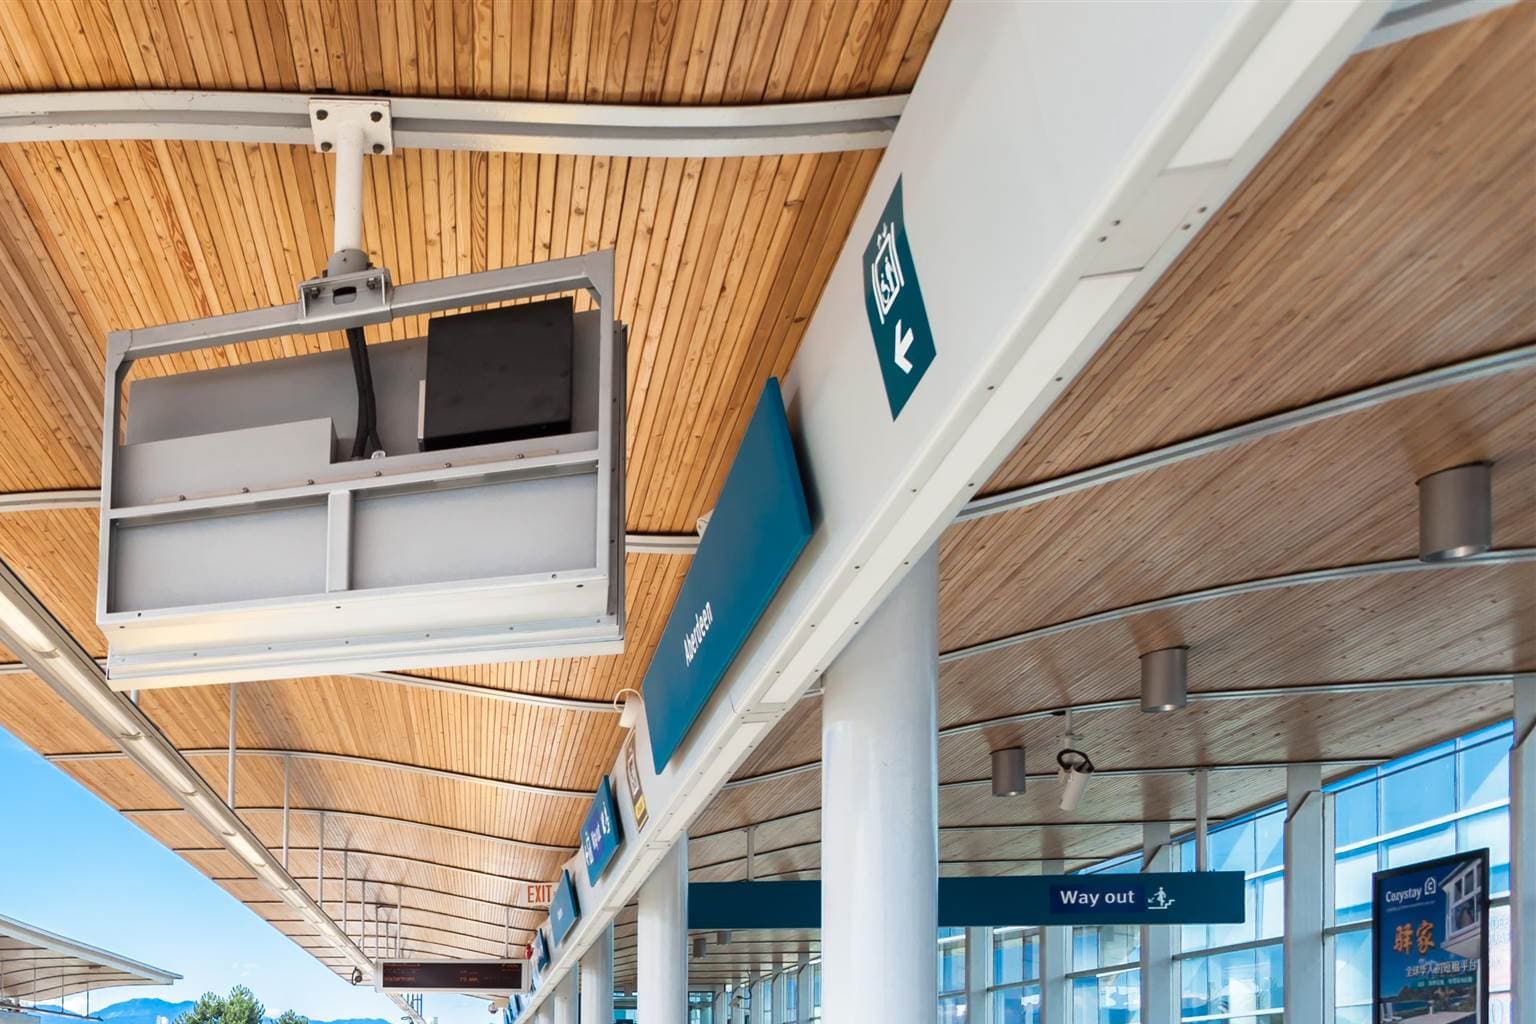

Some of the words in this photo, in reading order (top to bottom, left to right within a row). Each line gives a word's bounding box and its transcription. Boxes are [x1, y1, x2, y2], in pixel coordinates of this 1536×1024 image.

[684, 602, 713, 667] Aberdeen
[527, 885, 552, 903] EXIT
[1060, 890, 1099, 908] Way
[1105, 890, 1135, 904] out
[1385, 886, 1422, 905] Cozystay
